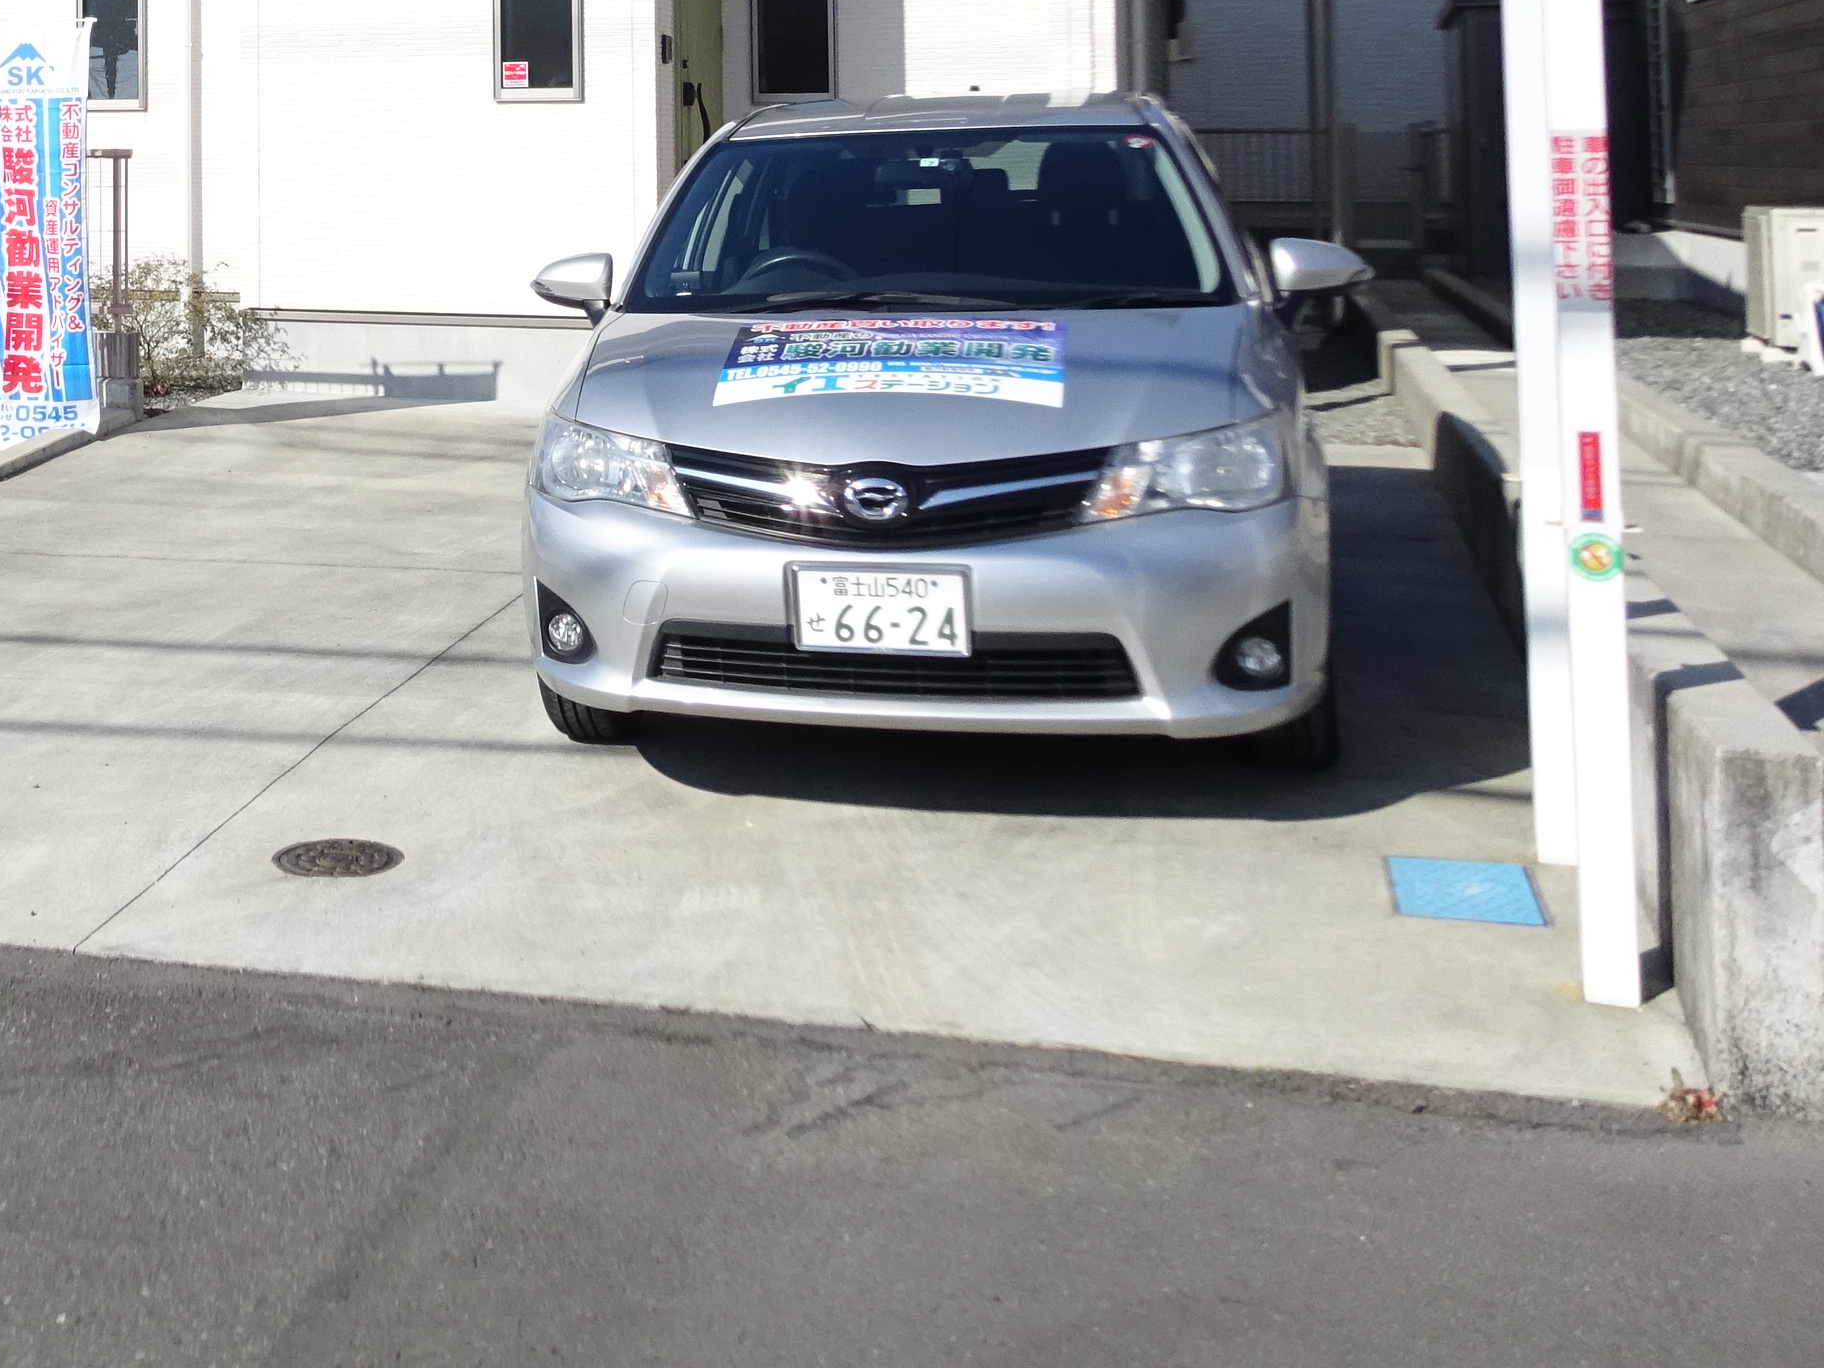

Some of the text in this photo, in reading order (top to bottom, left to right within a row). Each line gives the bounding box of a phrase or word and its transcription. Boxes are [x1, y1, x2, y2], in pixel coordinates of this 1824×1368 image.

[7, 65, 45, 87] SK
[2, 146, 44, 394] 駿河勧業開発
[44, 199, 65, 388] 資産運用アドバイザー
[780, 340, 1055, 362] 駿河勧業開発
[772, 375, 1000, 395] イエステーション
[15, 405, 79, 423] 0545
[834, 604, 959, 648] 66-24
